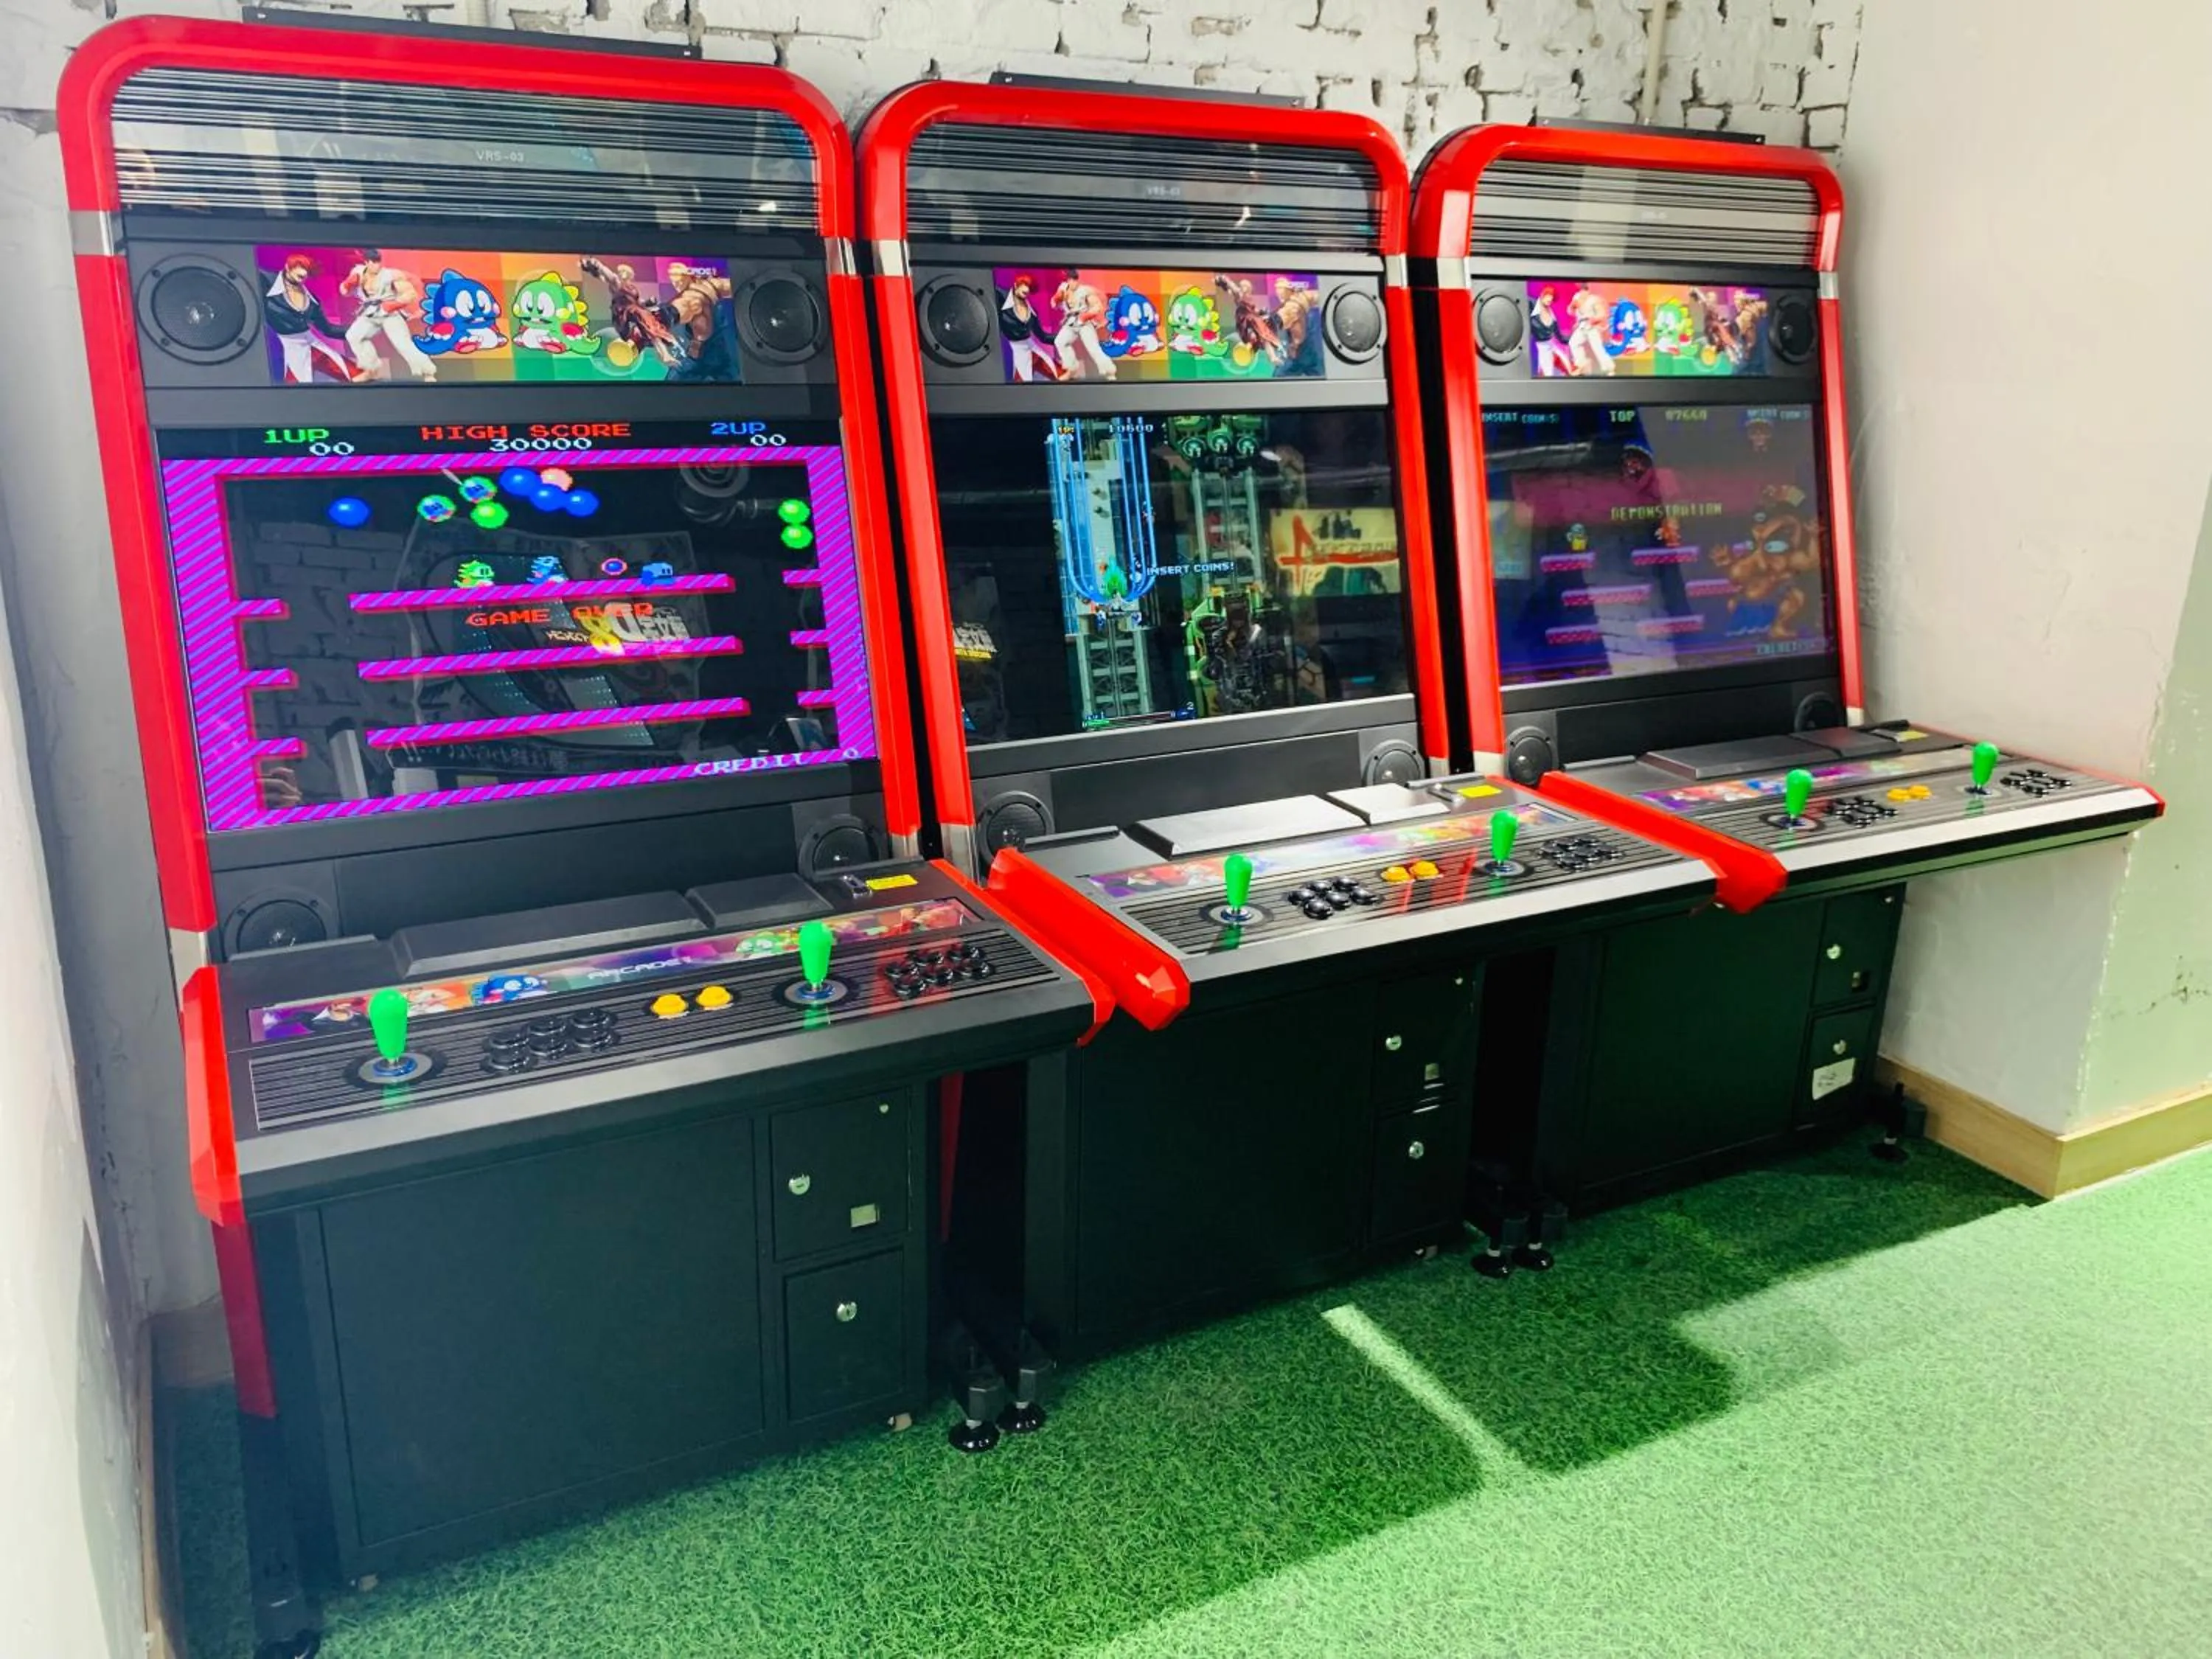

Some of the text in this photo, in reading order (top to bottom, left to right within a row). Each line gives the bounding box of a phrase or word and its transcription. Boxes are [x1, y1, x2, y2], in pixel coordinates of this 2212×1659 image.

[476, 150, 524, 161] VRS-03
[1609, 410, 1635, 422] TOP
[265, 428, 330, 443] 1UP
[420, 423, 632, 440] HIGH SCORE
[711, 422, 766, 435] 2UP
[489, 437, 592, 452] 30000
[750, 434, 787, 447] 00
[309, 442, 355, 456] 00
[1147, 561, 1235, 576] INSERT COINS!
[465, 608, 552, 626] GAME
[694, 752, 804, 775] CREDIT
